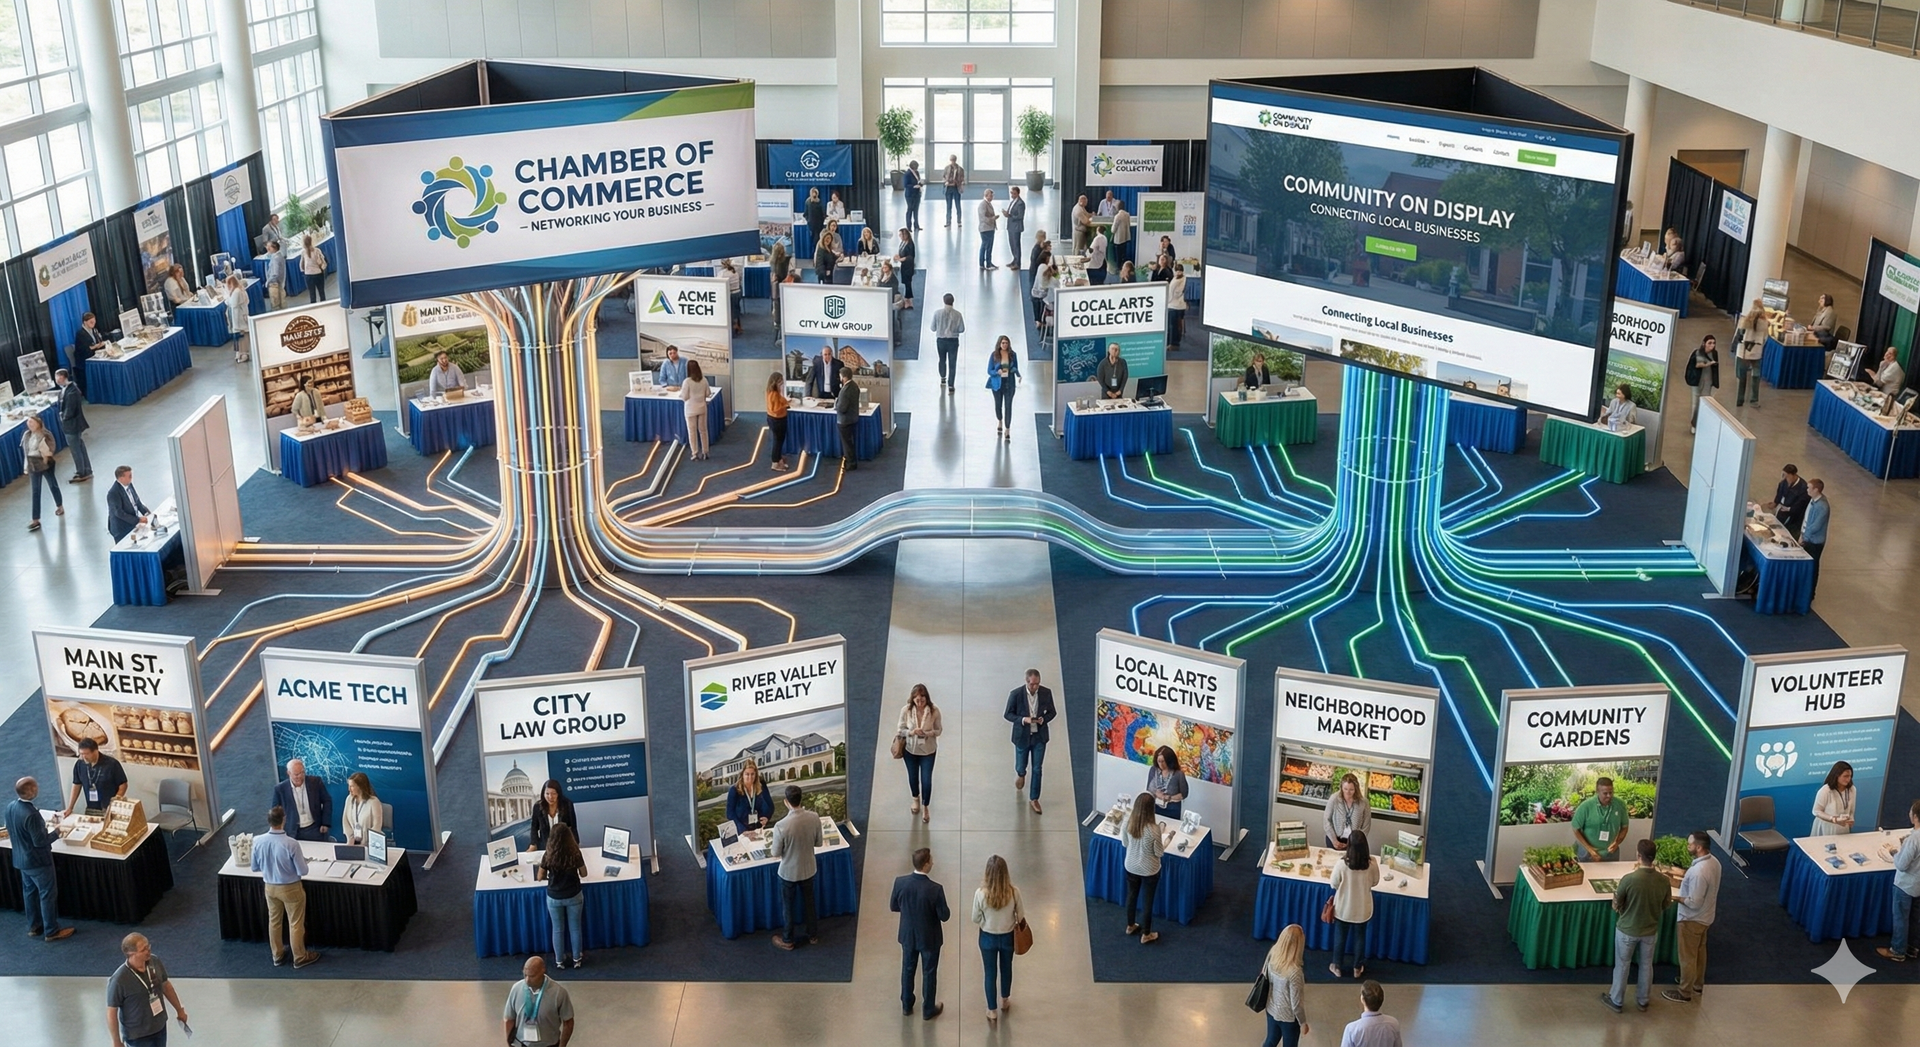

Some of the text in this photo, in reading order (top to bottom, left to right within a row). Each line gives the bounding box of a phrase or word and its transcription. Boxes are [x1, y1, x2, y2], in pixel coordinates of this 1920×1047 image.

[515, 140, 714, 184] CHAMBER OF
[1115, 165, 1156, 173] COLLECTIVE
[518, 170, 704, 214] COMMERCE
[1283, 174, 1515, 229] COMMUNITY ON DISPLAY
[531, 201, 702, 231] NETWORKING YOUR BUSINESS
[1310, 202, 1481, 244] CONNECTING LOCAL BUSINESSES
[677, 290, 717, 303] ACME
[1071, 296, 1154, 313] LOCAL ARTS
[420, 306, 441, 317] MAIN
[443, 305, 455, 314] ST.
[678, 303, 714, 316] TECH
[1070, 311, 1153, 327] COLLECTIVE
[799, 320, 873, 331] CITY LAW GROUP
[1321, 305, 1373, 327] Connecting
[1375, 317, 1399, 332] Local
[1401, 322, 1454, 343] Businesses
[1612, 312, 1666, 334] BORHOOD
[1610, 327, 1652, 347] ARKET
[64, 647, 164, 674] MAIN ST.
[1115, 654, 1217, 692] LOCAL ARTS
[71, 671, 162, 696] BAKERY
[732, 659, 837, 692] RIVER VALLEY
[1770, 668, 1884, 693] VOLUNTEER
[277, 678, 408, 705] ACME TECH
[533, 692, 591, 716] CITY
[754, 682, 812, 705] REALTY
[1115, 675, 1216, 712] COLLECTIVE
[1805, 692, 1846, 711] HUB
[1285, 691, 1426, 726] NEIGHBORHOOD
[1527, 706, 1647, 728] COMMUNITY
[500, 713, 626, 740] LAW GROUP
[1317, 716, 1391, 741] MARKET
[1540, 728, 1630, 748] GARDENS
